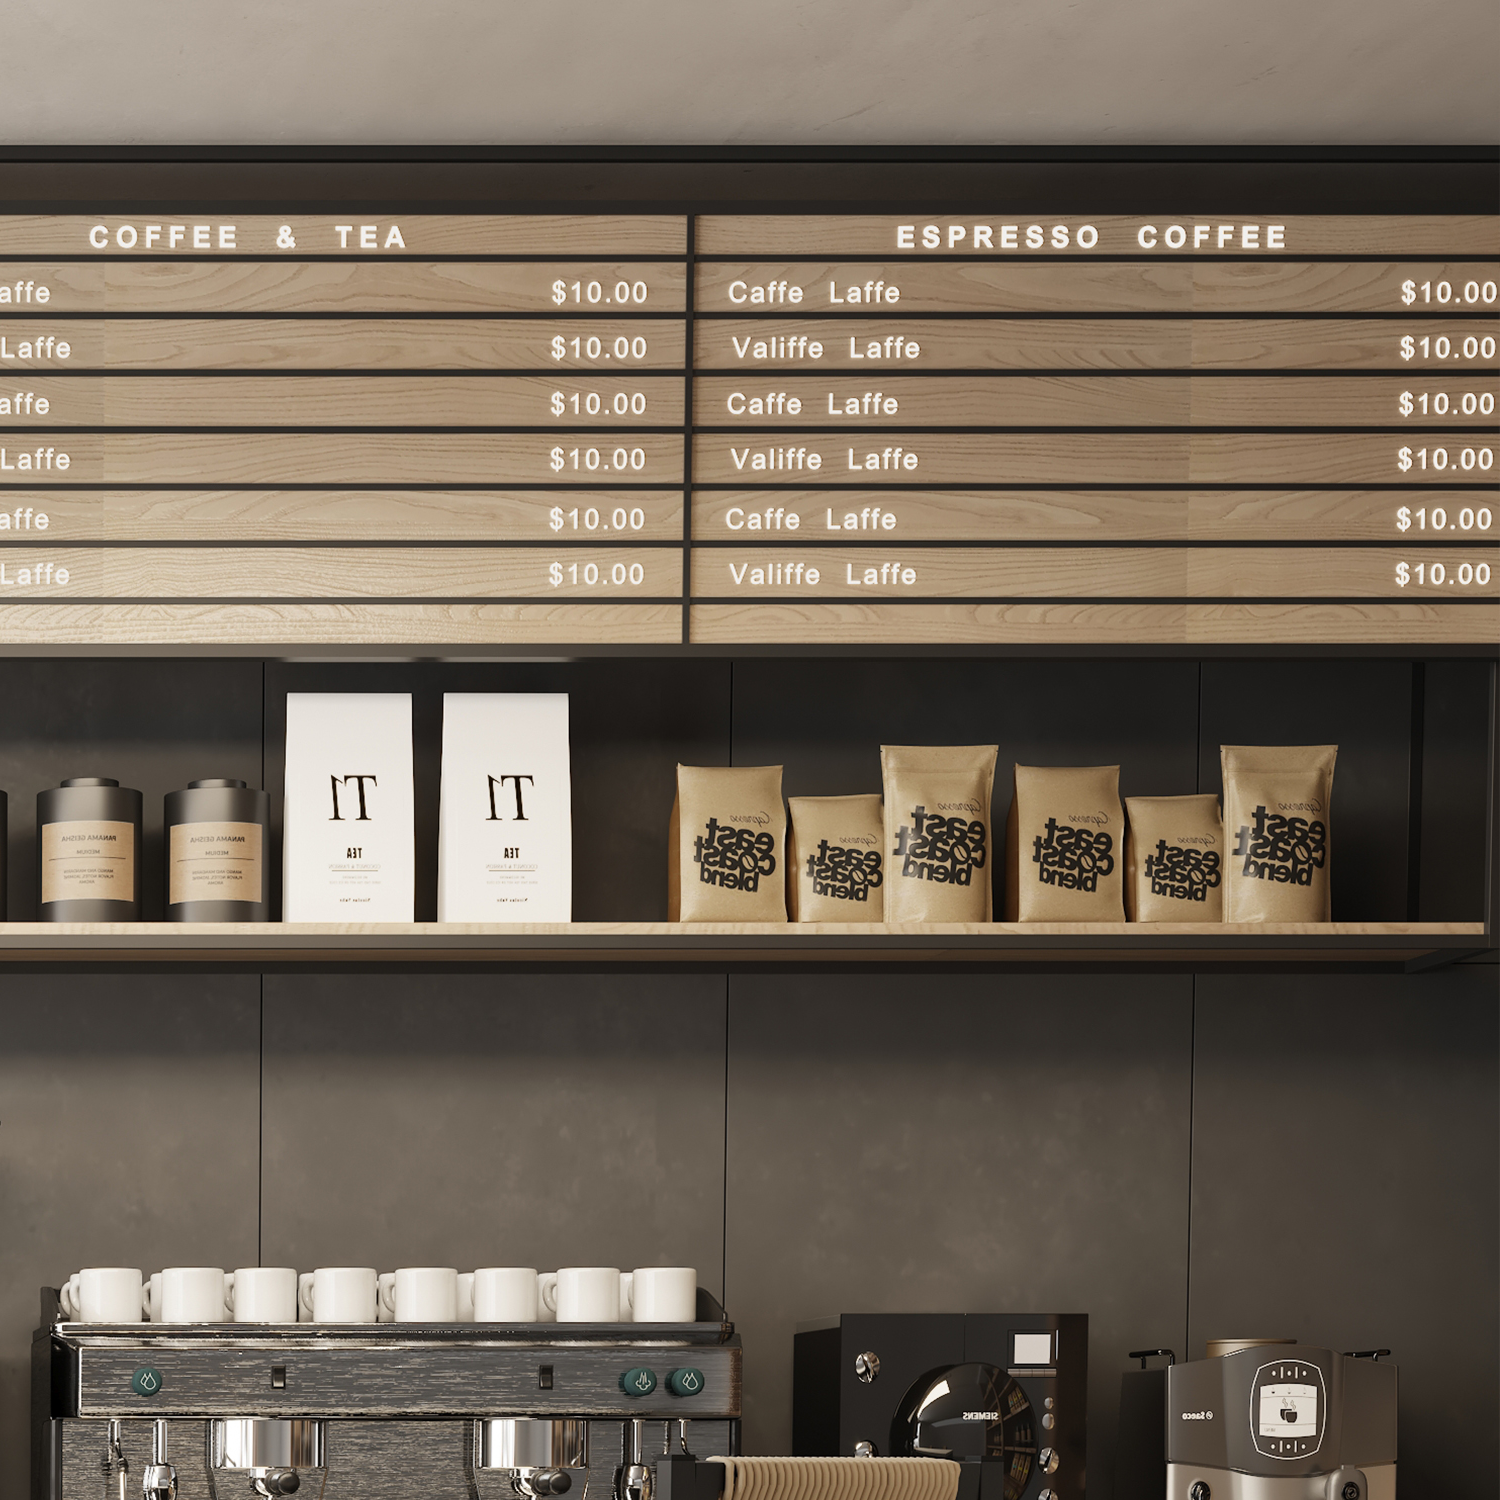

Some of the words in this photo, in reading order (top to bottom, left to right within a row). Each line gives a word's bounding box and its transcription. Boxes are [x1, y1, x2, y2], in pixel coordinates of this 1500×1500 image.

[88, 224, 237, 249] COFFEE
[275, 224, 297, 250] &
[334, 225, 406, 249] TEA
[896, 224, 1099, 250] ESPRESSO
[1137, 224, 1285, 250] COFFEE
[551, 279, 648, 306] $10.00
[727, 280, 804, 304] Caffe
[829, 280, 900, 304] Laffe
[1400, 279, 1498, 306] $10.00
[0, 336, 71, 359] Laffe
[550, 334, 647, 362] $10.00
[731, 335, 824, 360] Valiffe
[849, 335, 920, 360] Laffe
[1399, 334, 1497, 362] $10.00
[550, 390, 646, 418] $10.00
[726, 392, 802, 415] Caffe
[827, 392, 899, 415] Laffe
[1398, 390, 1495, 418] $10.00
[0, 447, 71, 471] Laffe
[549, 445, 646, 473] $10.00
[730, 447, 822, 471] Valiffe
[847, 447, 919, 471] Laffe
[1397, 445, 1494, 473] $10.00
[548, 505, 645, 533] $10.00
[724, 506, 801, 531] Caffe
[825, 506, 897, 531] Laffe
[1395, 505, 1493, 533] $10.00
[0, 562, 70, 586] Laffe
[548, 561, 644, 588] $10.00
[728, 561, 821, 586] Valiffe
[845, 561, 917, 586] Laffe
[1394, 560, 1491, 588] $10.00
